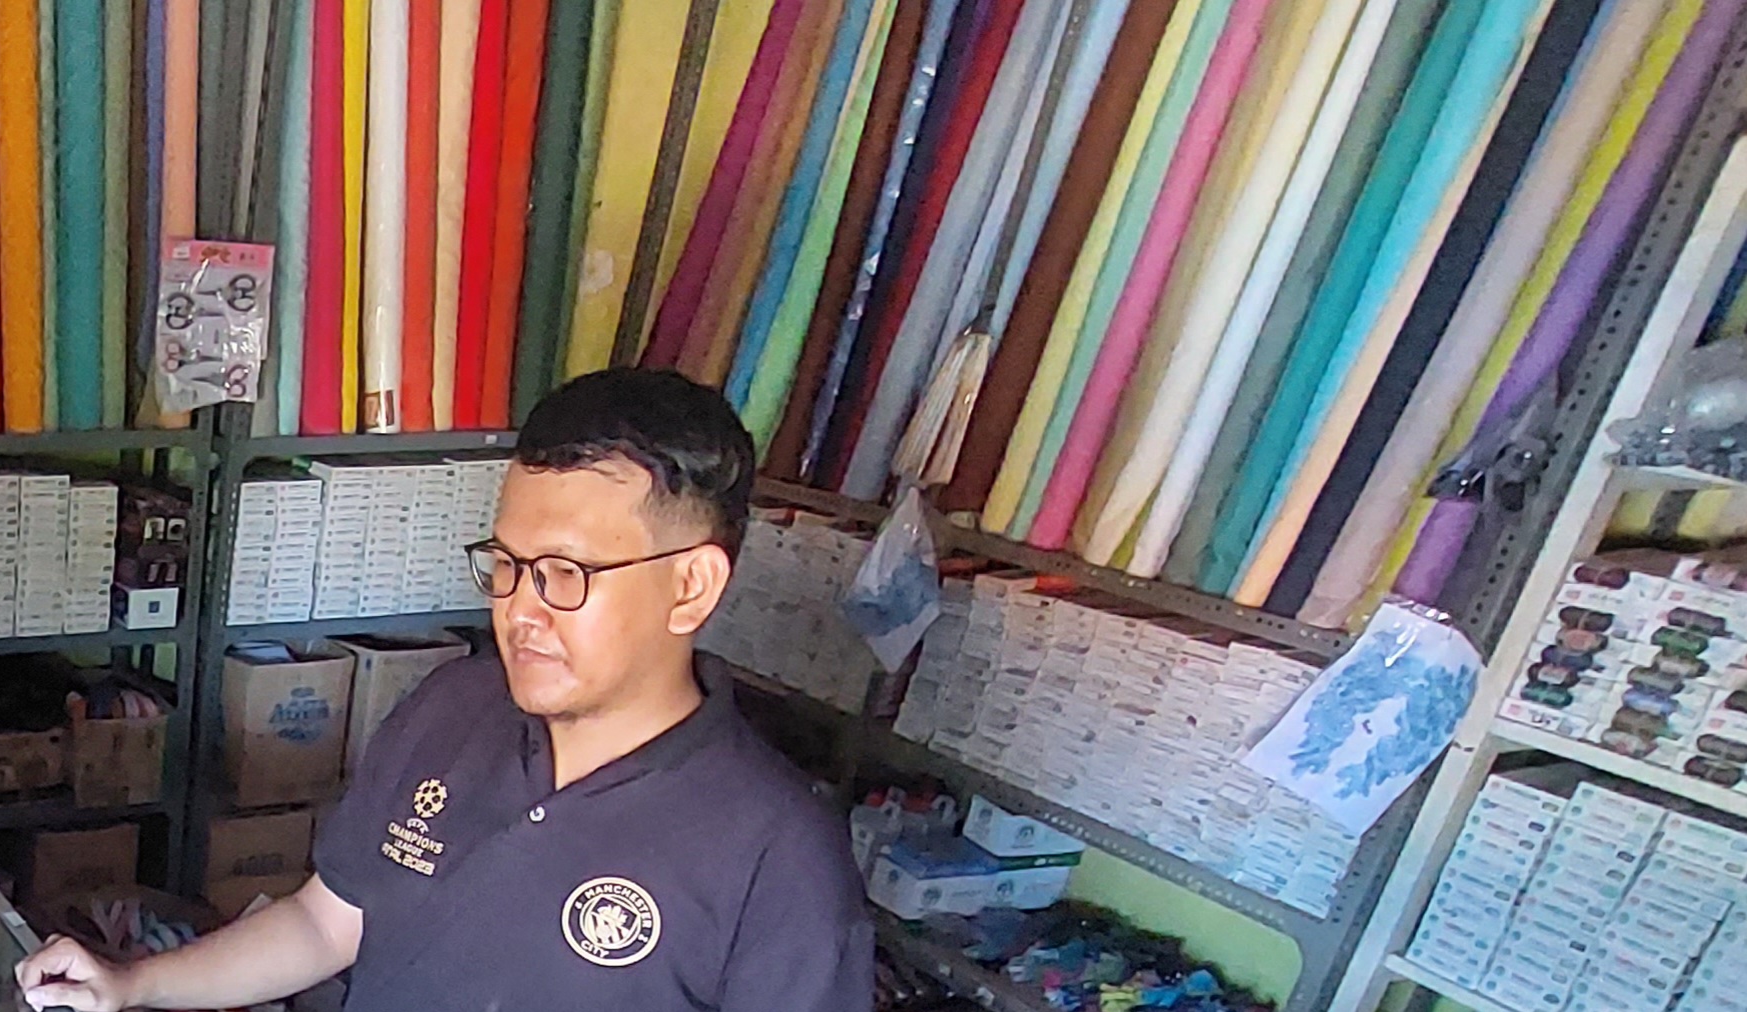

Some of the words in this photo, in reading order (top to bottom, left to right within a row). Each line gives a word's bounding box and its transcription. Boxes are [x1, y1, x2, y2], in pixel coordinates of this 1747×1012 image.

[387, 821, 445, 855] CHAMPIONS
[393, 839, 425, 859] LEAGUE
[584, 883, 653, 930] MANCHESTER
[580, 939, 610, 959] CITY
